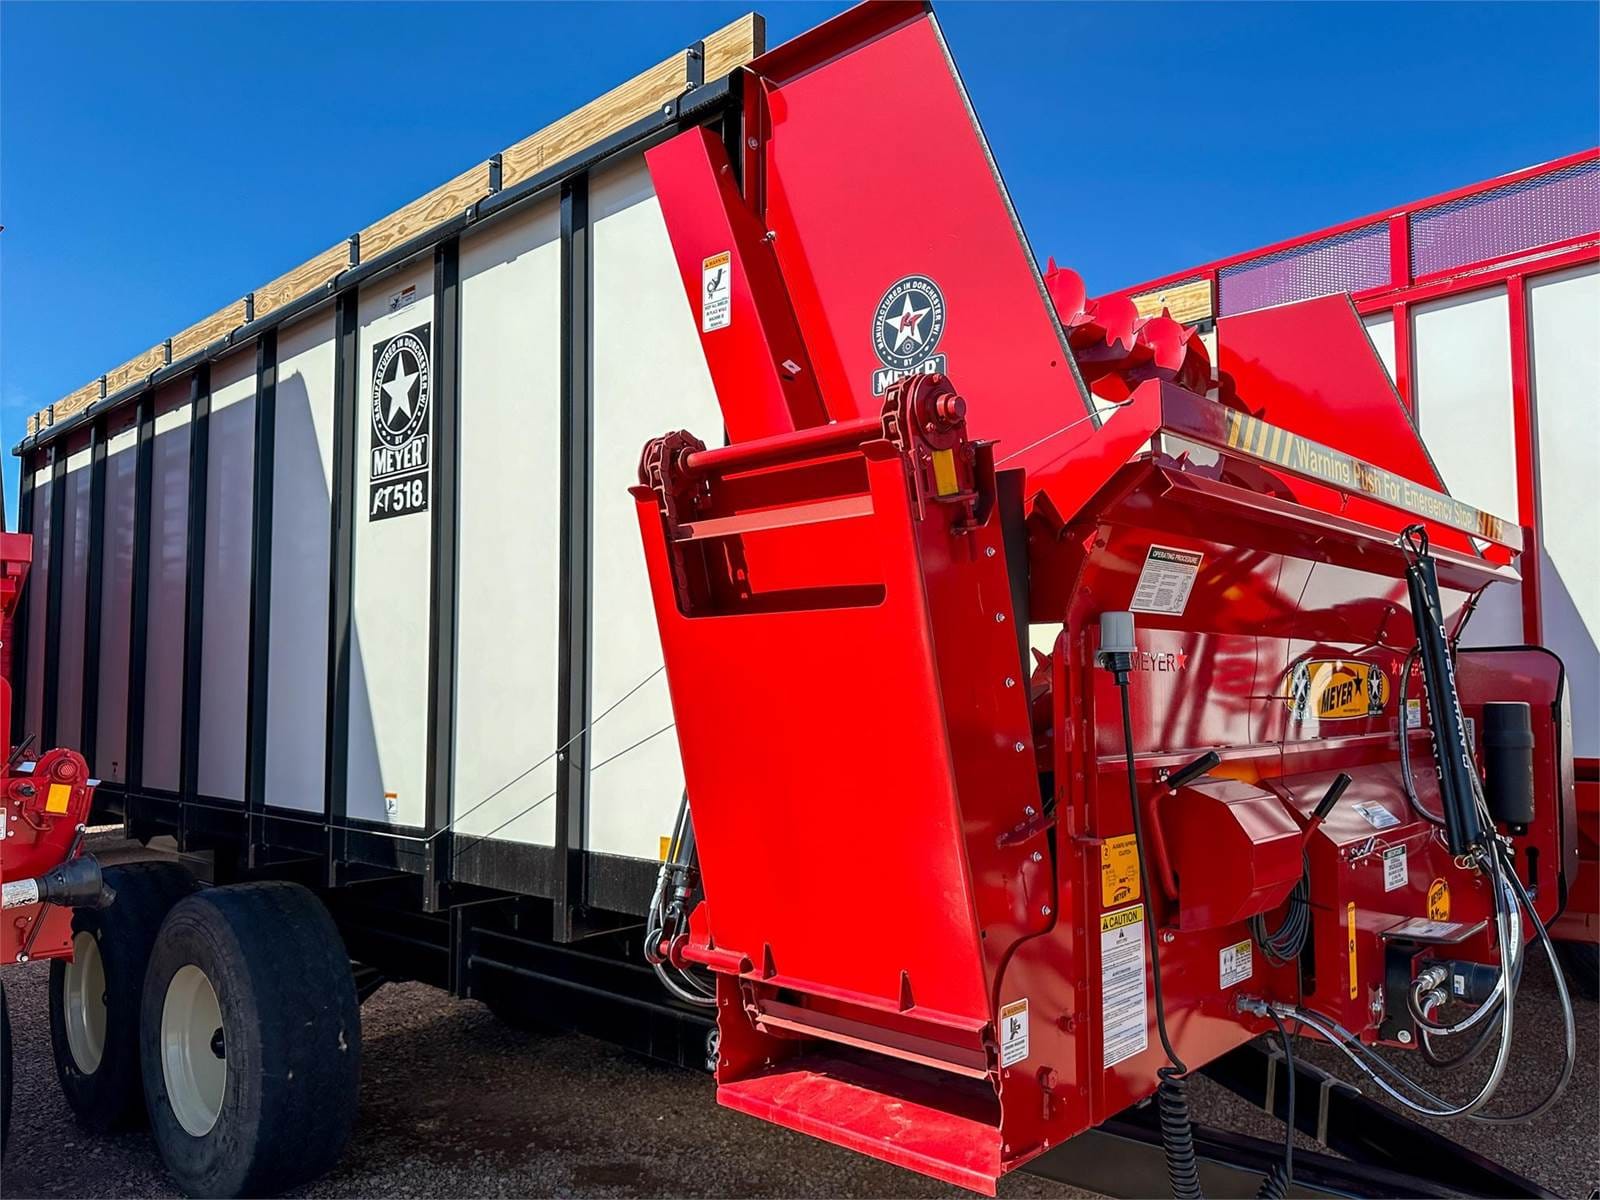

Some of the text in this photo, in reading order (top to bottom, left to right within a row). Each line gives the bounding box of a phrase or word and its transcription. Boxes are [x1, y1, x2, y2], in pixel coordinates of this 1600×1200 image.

[876, 287, 902, 350] MANUFACTURED
[903, 281, 911, 290] IN
[912, 281, 942, 318] DORCHESTER
[373, 343, 398, 421] MANUFACTURED
[396, 338, 404, 348] IN
[903, 358, 913, 367] BY
[395, 434, 404, 445] BY
[373, 438, 423, 476] MEYER
[1352, 460, 1381, 495] Push
[1383, 473, 1400, 500] For
[1403, 481, 1452, 521] Emergency
[1454, 502, 1472, 529] Stop
[1152, 550, 1199, 564] OPERATING PROCEDURE
[1321, 680, 1354, 714] MEYER
[1109, 910, 1138, 928] CAUTION
